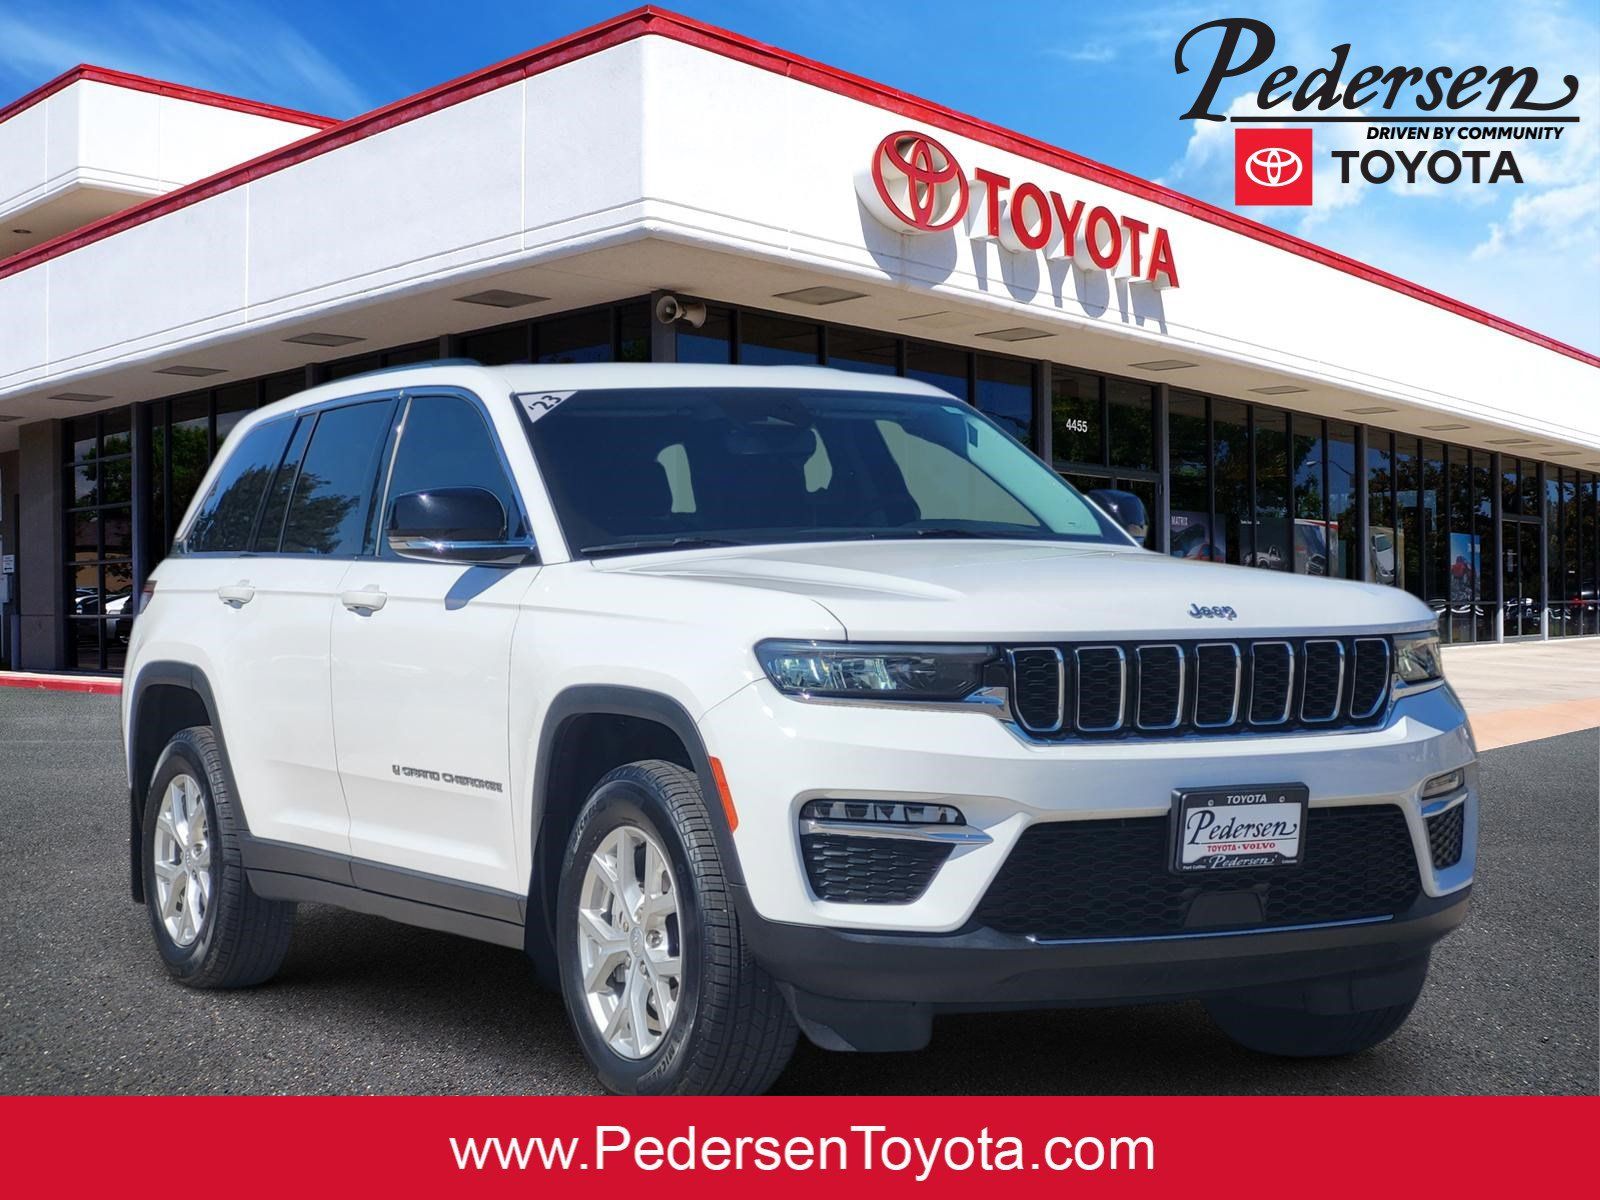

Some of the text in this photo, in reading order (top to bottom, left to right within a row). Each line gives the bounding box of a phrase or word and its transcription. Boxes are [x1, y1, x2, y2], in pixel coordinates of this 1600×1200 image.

[975, 167, 1179, 289] TOYOTA
[1065, 418, 1088, 433] 4455
[1189, 603, 1238, 621] Jeep
[402, 766, 503, 793] GRAND CHEROKEE
[1226, 794, 1267, 805] TOYOTA
[1186, 809, 1298, 845] Pedersen
[1207, 842, 1276, 853] TOYOTA VOLVO
[1208, 854, 1276, 869] Pedersen
